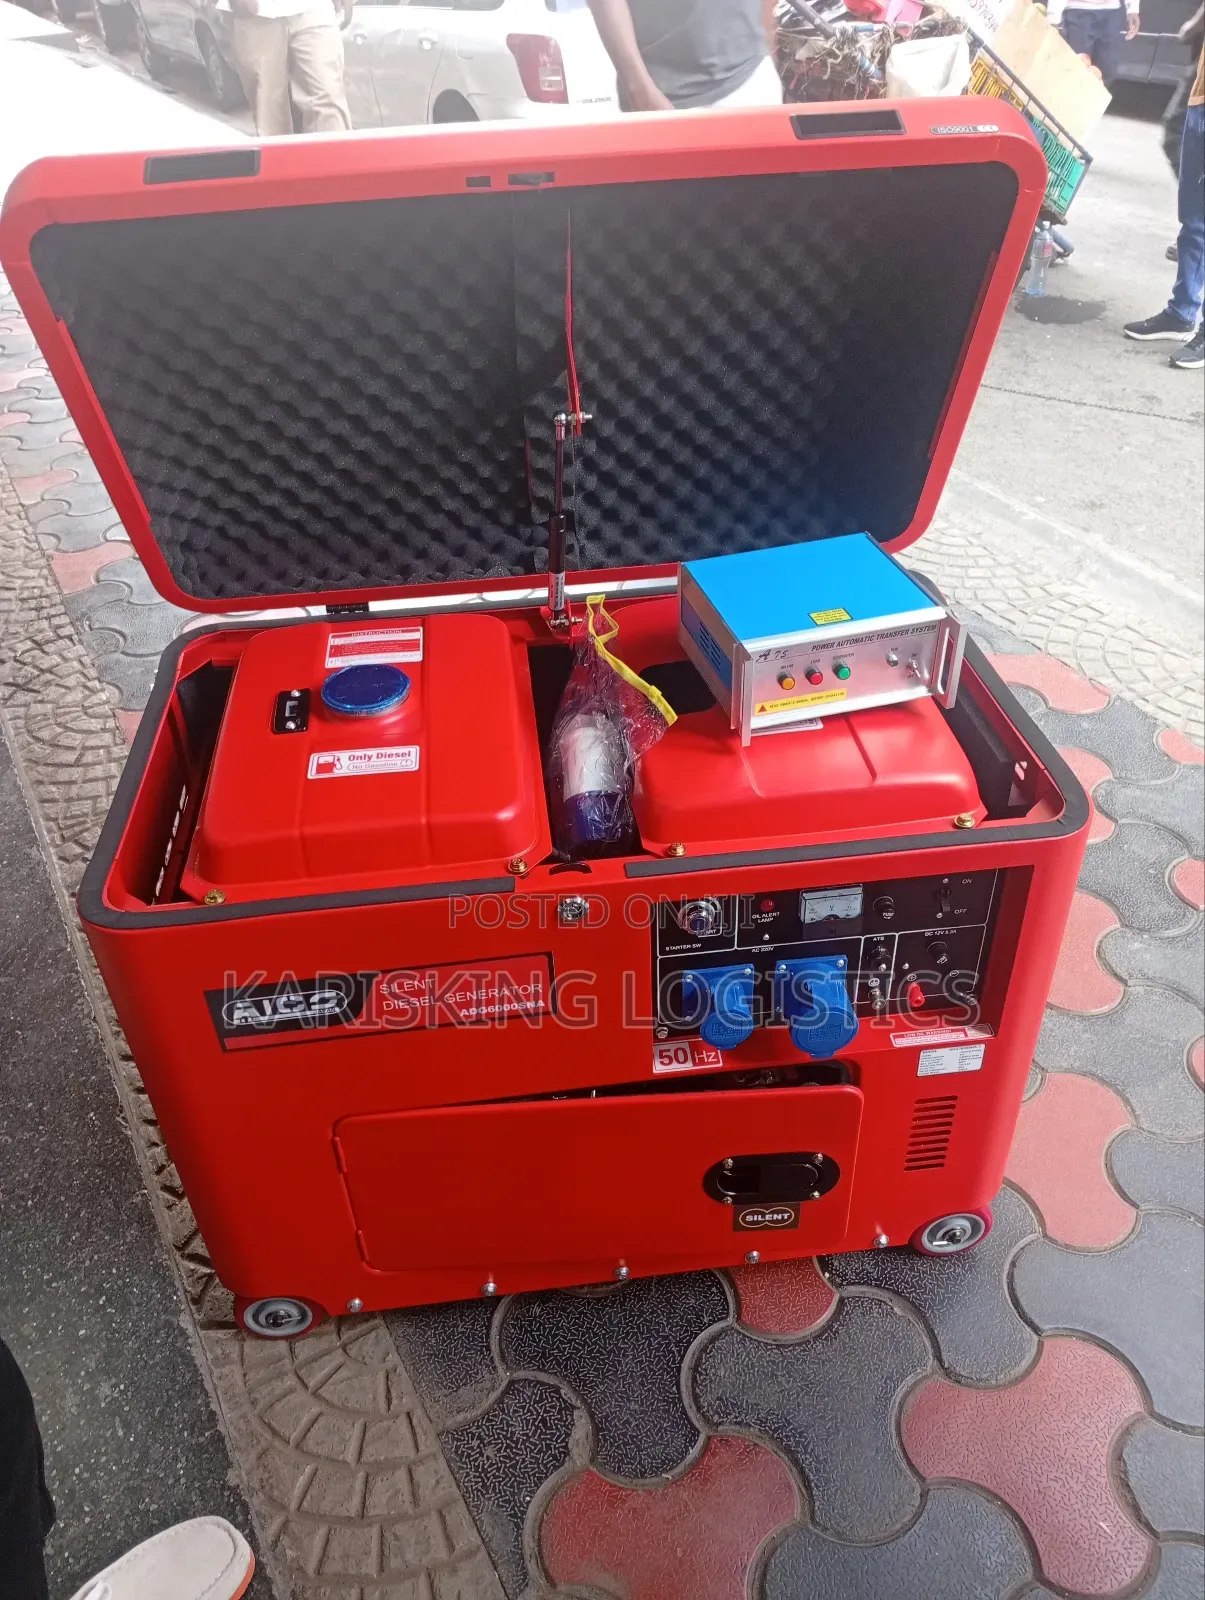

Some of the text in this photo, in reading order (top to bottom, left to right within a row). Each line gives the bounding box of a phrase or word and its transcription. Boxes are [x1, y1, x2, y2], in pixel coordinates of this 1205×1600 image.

[937, 125, 974, 134] ISO9001
[811, 624, 937, 652] POWER AUTOMATIC TRANSFER SYSTEM
[348, 750, 411, 761] Only Diesel
[379, 979, 435, 994] SILENT
[383, 983, 543, 1012] DIESEL GENERATOR
[460, 999, 546, 1017] ADG6000SNA
[658, 1047, 718, 1067] 50 Hz
[745, 1213, 791, 1222] SILENT
